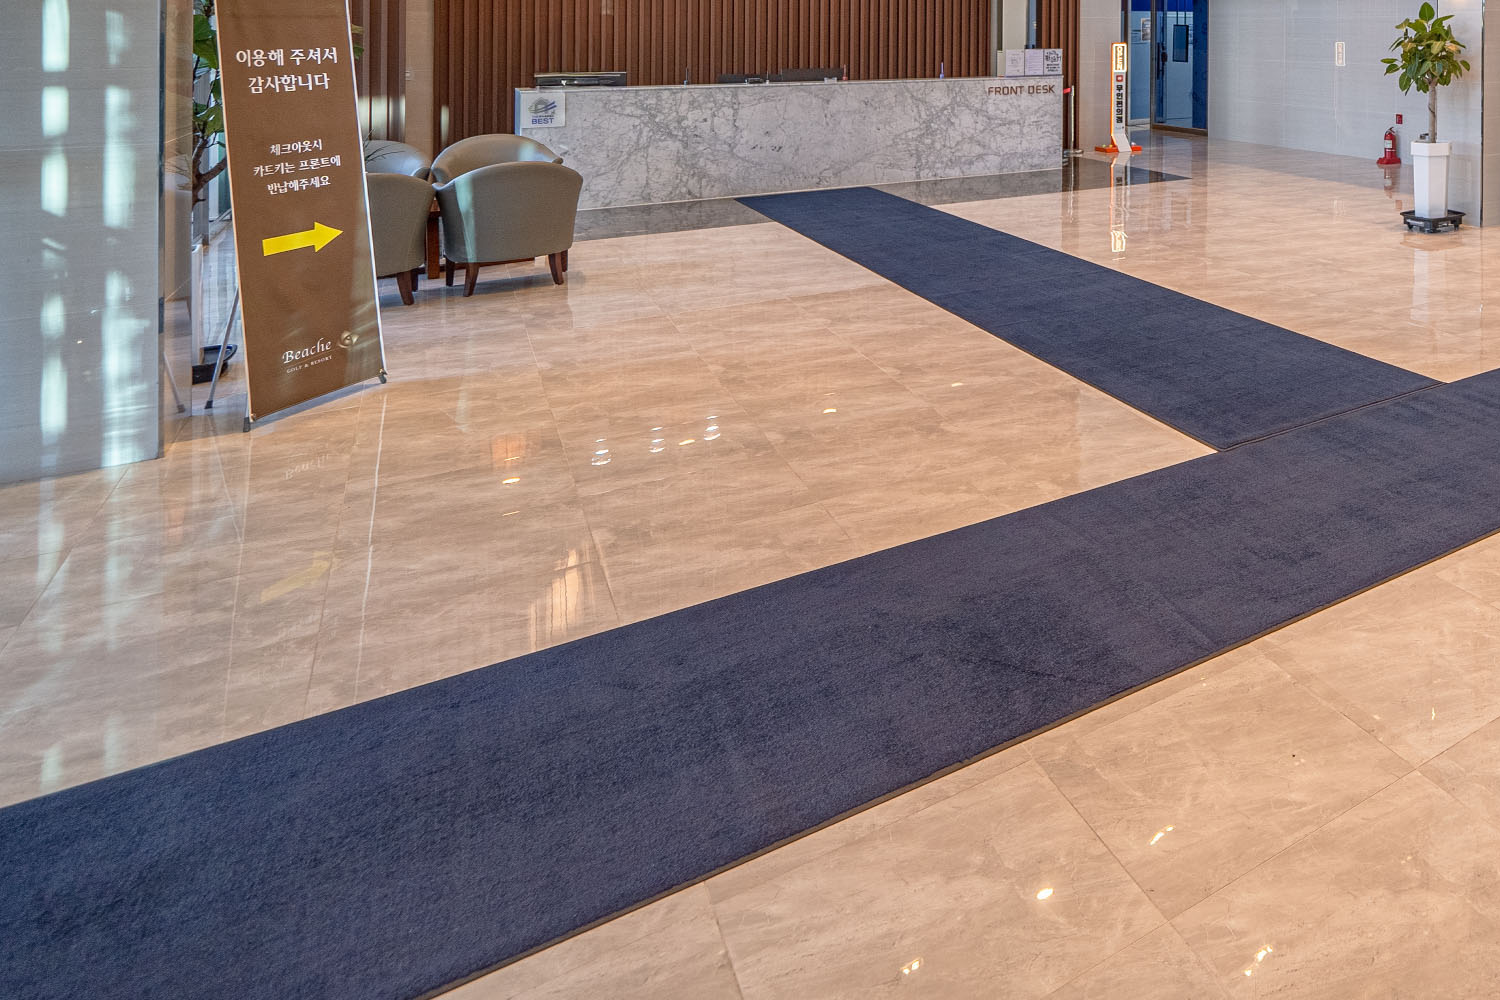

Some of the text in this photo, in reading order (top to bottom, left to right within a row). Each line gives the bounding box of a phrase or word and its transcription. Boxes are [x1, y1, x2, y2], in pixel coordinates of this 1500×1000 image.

[236, 47, 338, 67] 이용해 주셔서
[248, 72, 330, 94] 감사합니다
[987, 84, 1055, 96] FRONT DESK
[1115, 84, 1124, 124] 무인편의점
[531, 117, 555, 125] BEST
[270, 138, 322, 156] 체크아웃시
[253, 154, 341, 177] 카드키는 프론트에
[267, 175, 331, 195] 반납해주세요
[282, 337, 332, 364] Beache
[286, 365, 302, 374] GOLF
[310, 355, 333, 366] RESORT
